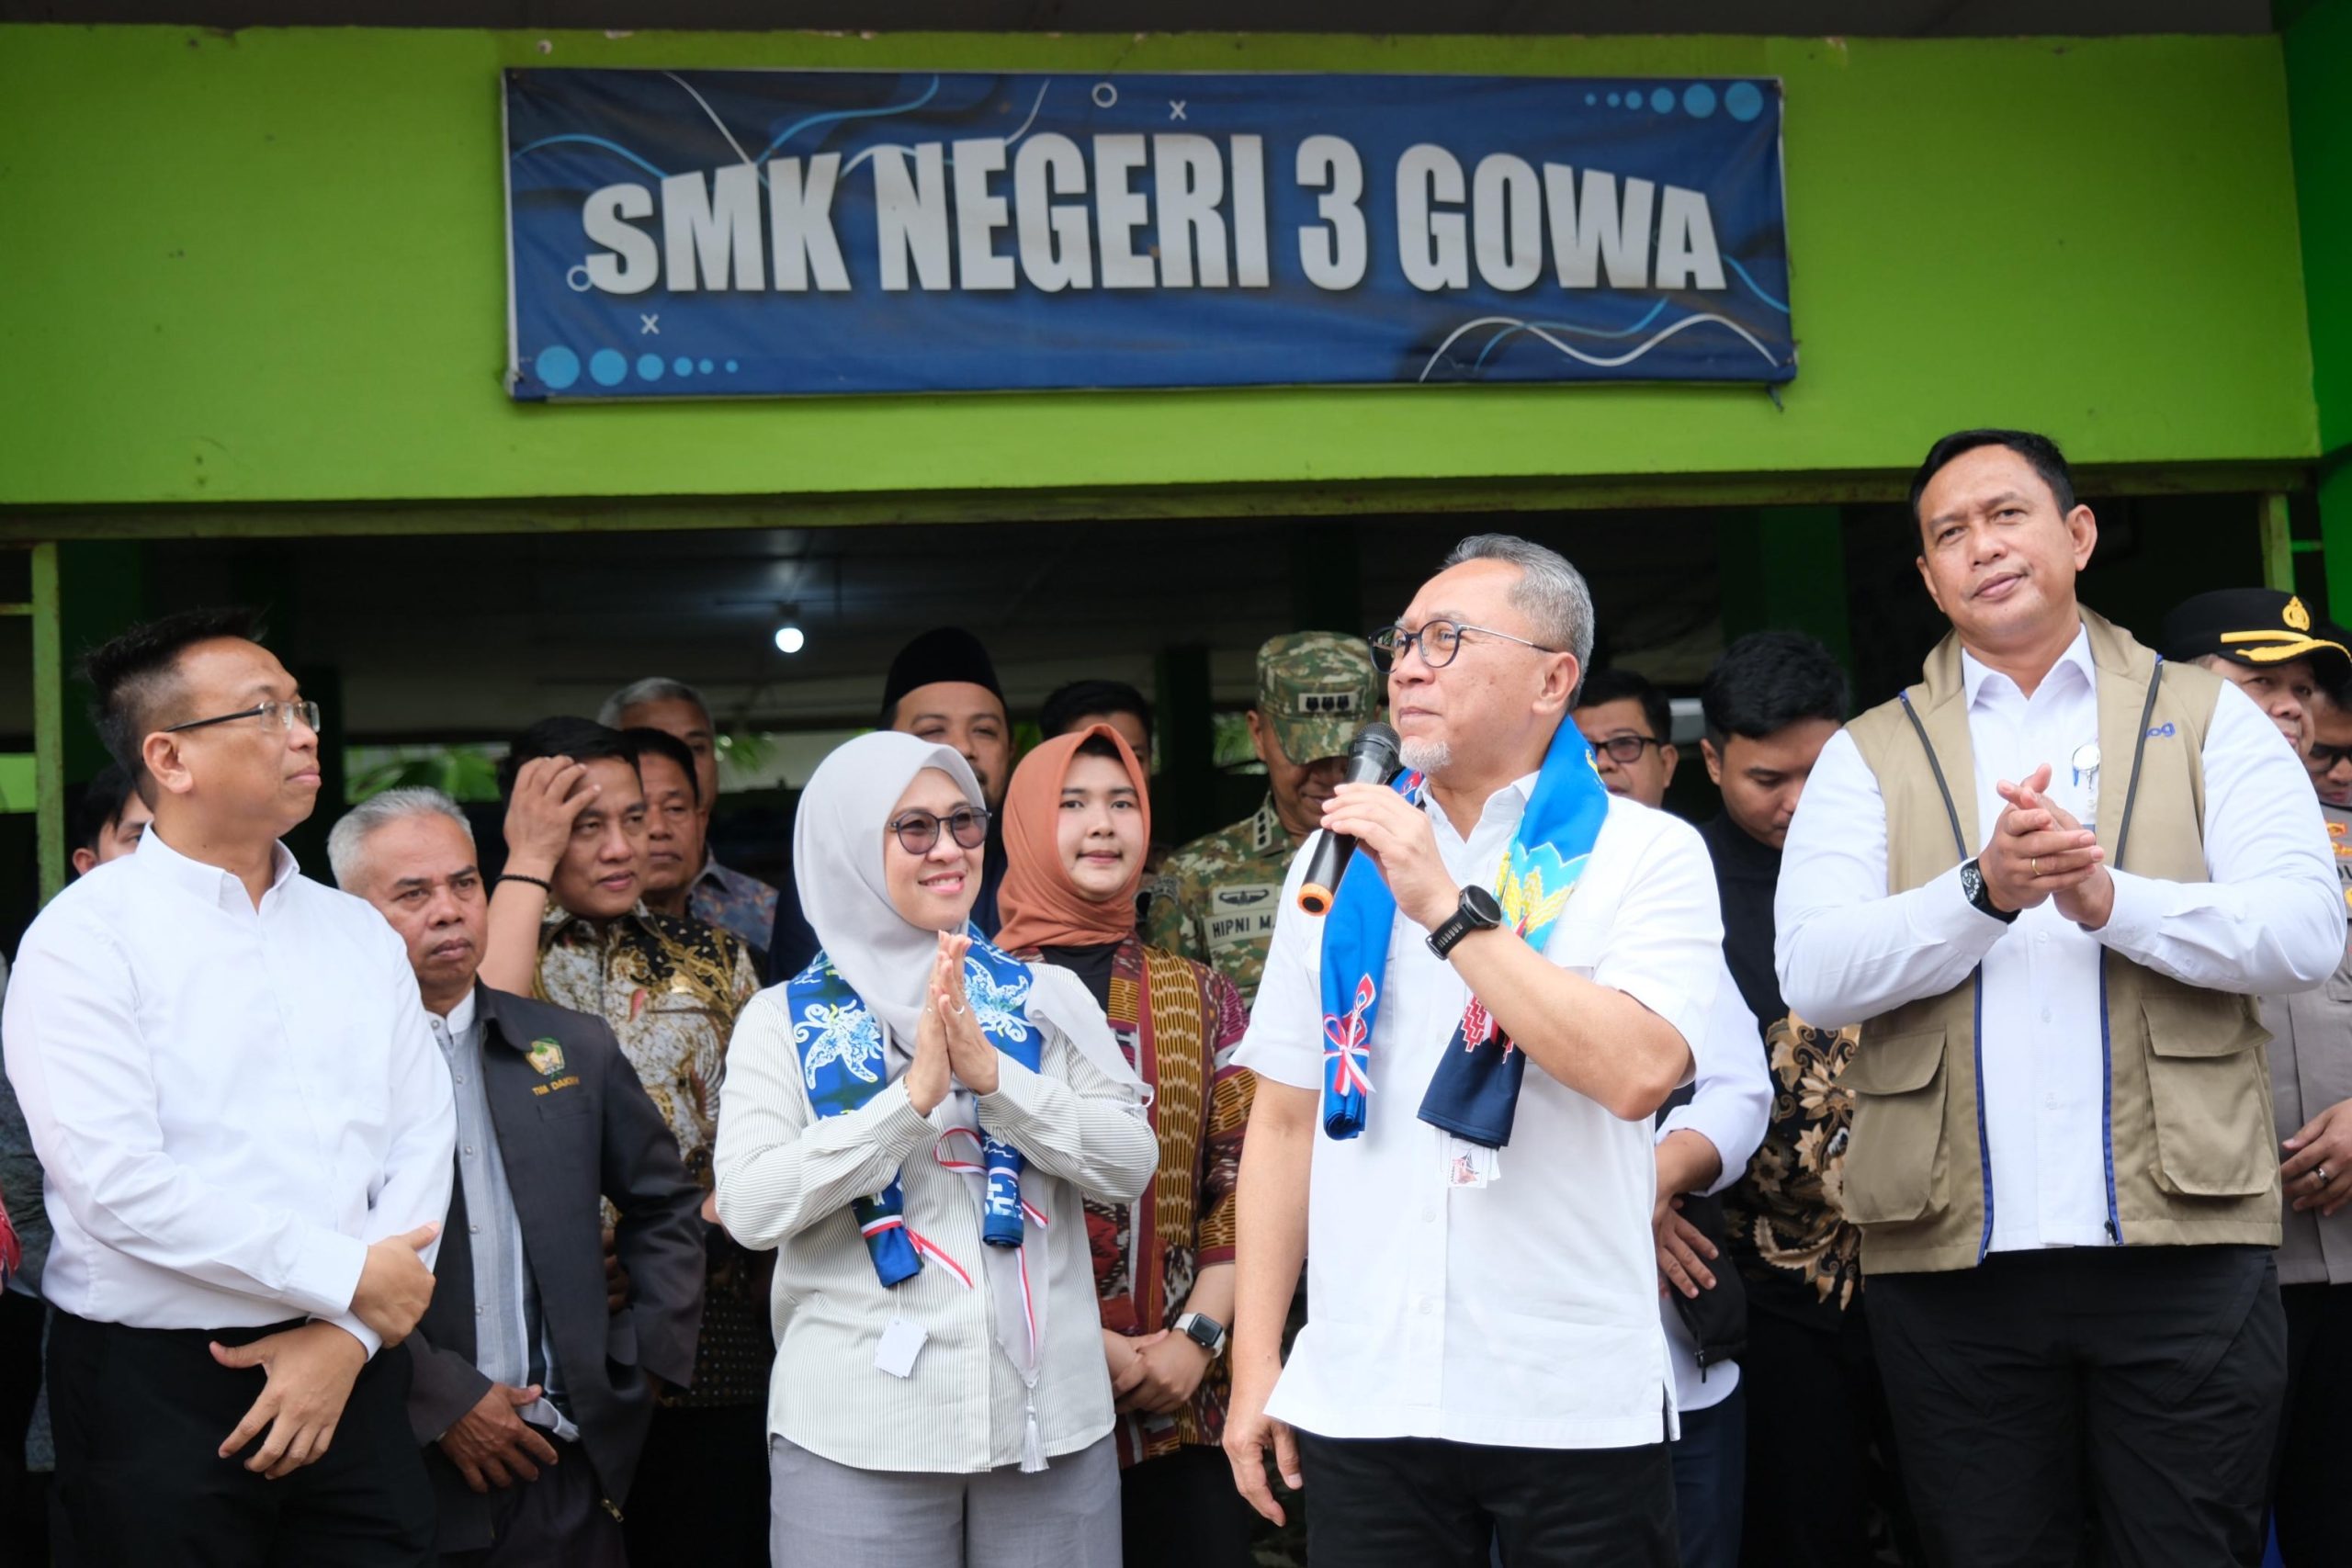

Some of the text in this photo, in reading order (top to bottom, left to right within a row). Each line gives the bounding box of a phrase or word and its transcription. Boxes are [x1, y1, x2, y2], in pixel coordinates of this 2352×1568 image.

[582, 132, 1727, 294] SMK NEGERI 3 GOWA
[1212, 917, 1250, 938] HIPNI
[532, 1085, 549, 1095] TIM
